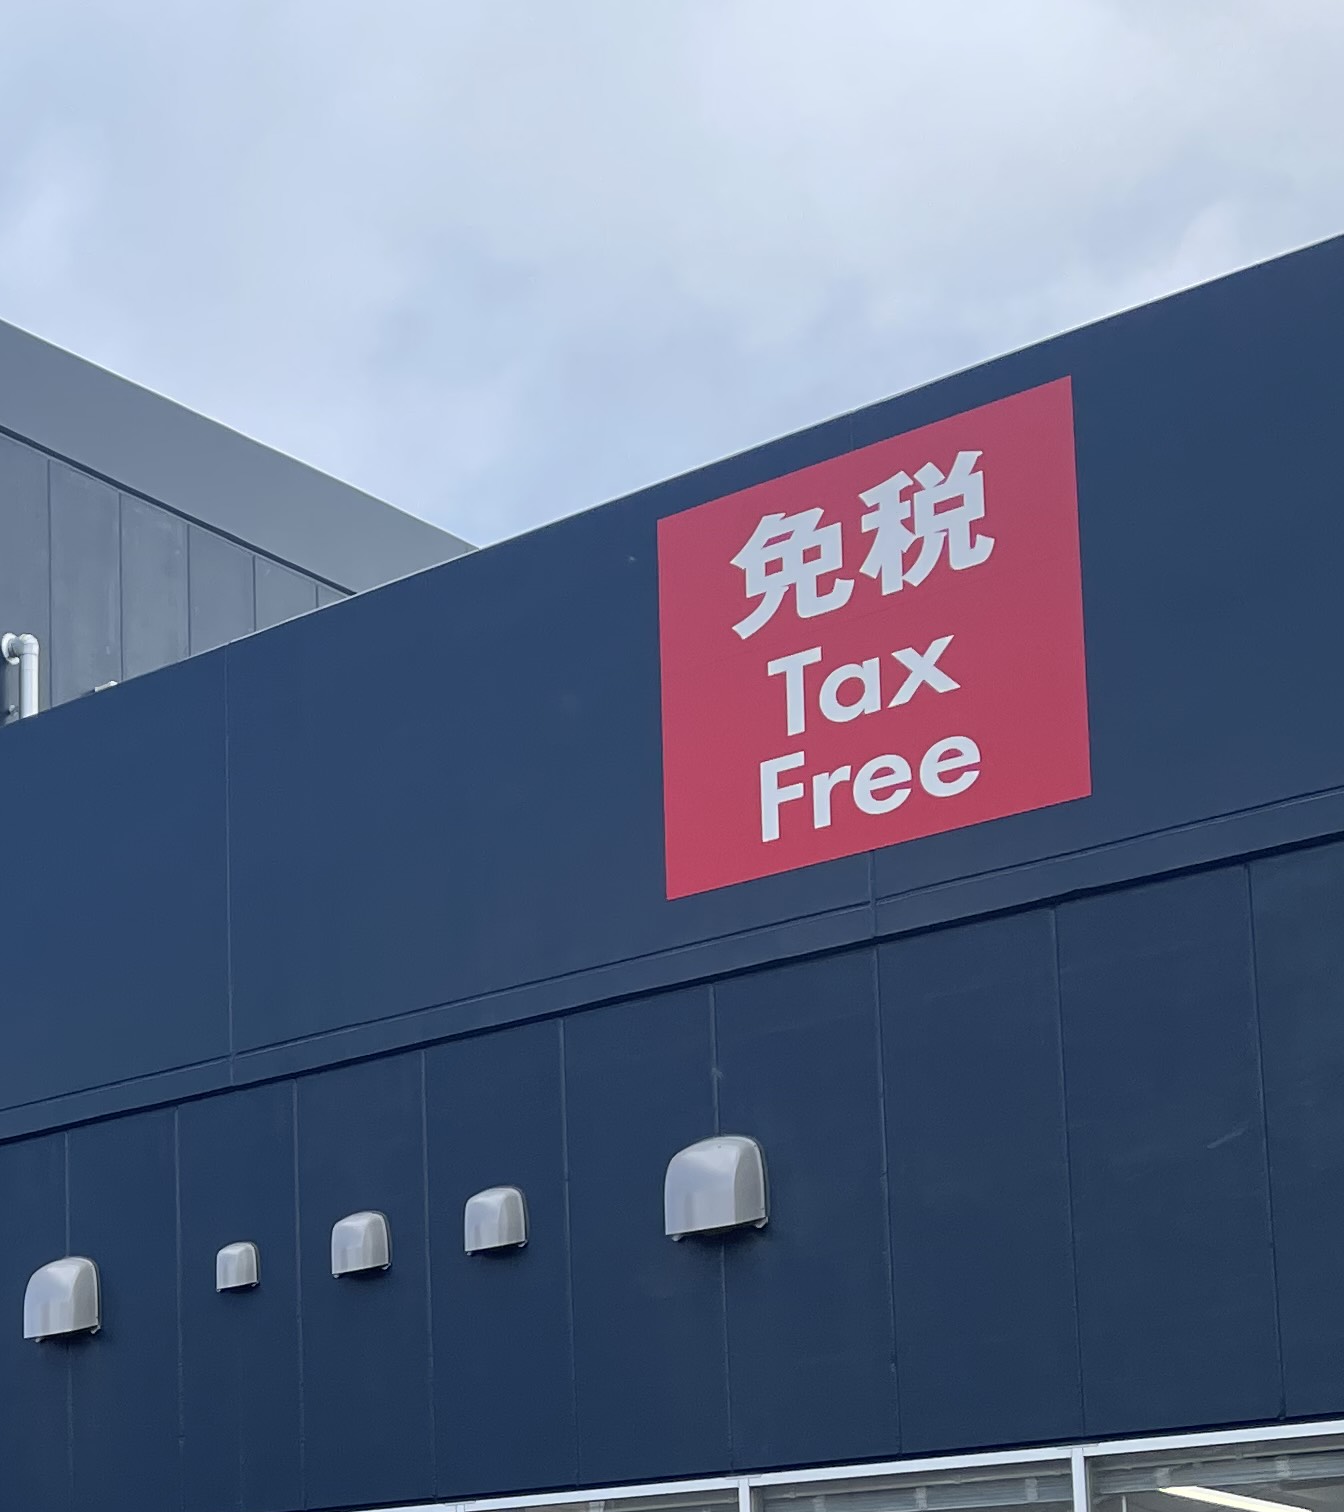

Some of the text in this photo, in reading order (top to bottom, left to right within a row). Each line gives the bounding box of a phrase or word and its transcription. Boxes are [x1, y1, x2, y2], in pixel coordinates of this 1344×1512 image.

[730, 451, 995, 639] 免税
[768, 634, 961, 737] Tax
[760, 735, 981, 843] Free
